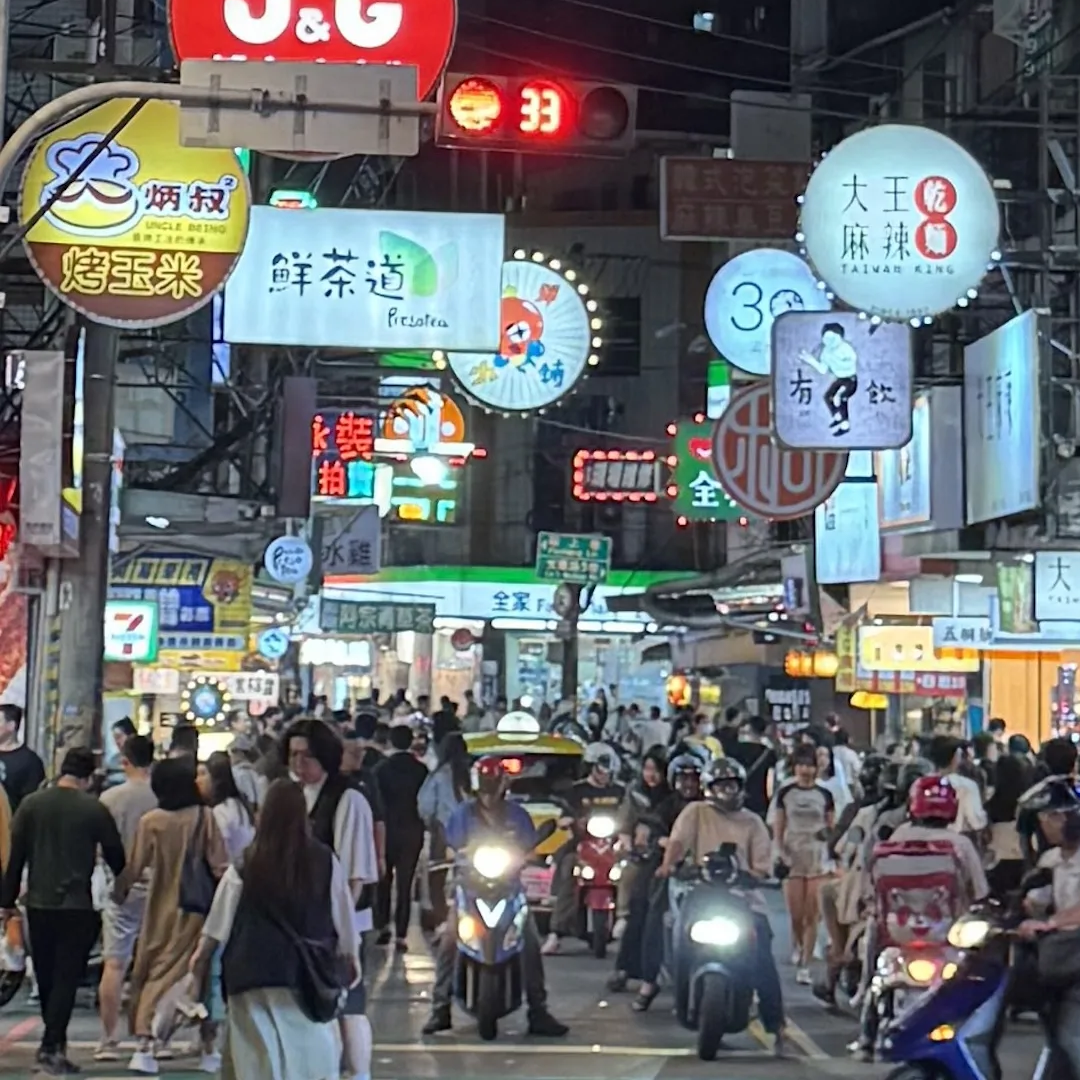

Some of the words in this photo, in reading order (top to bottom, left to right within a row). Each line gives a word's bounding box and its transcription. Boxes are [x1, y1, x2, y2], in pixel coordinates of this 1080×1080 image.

[519, 87, 560, 133] 33
[145, 183, 224, 214] 炳叔
[842, 174, 909, 213] 大王
[841, 222, 910, 262] 麻辣
[60, 247, 203, 300] 烤玉米
[269, 247, 405, 300] 鮮茶道
[492, 590, 532, 612] 全家
